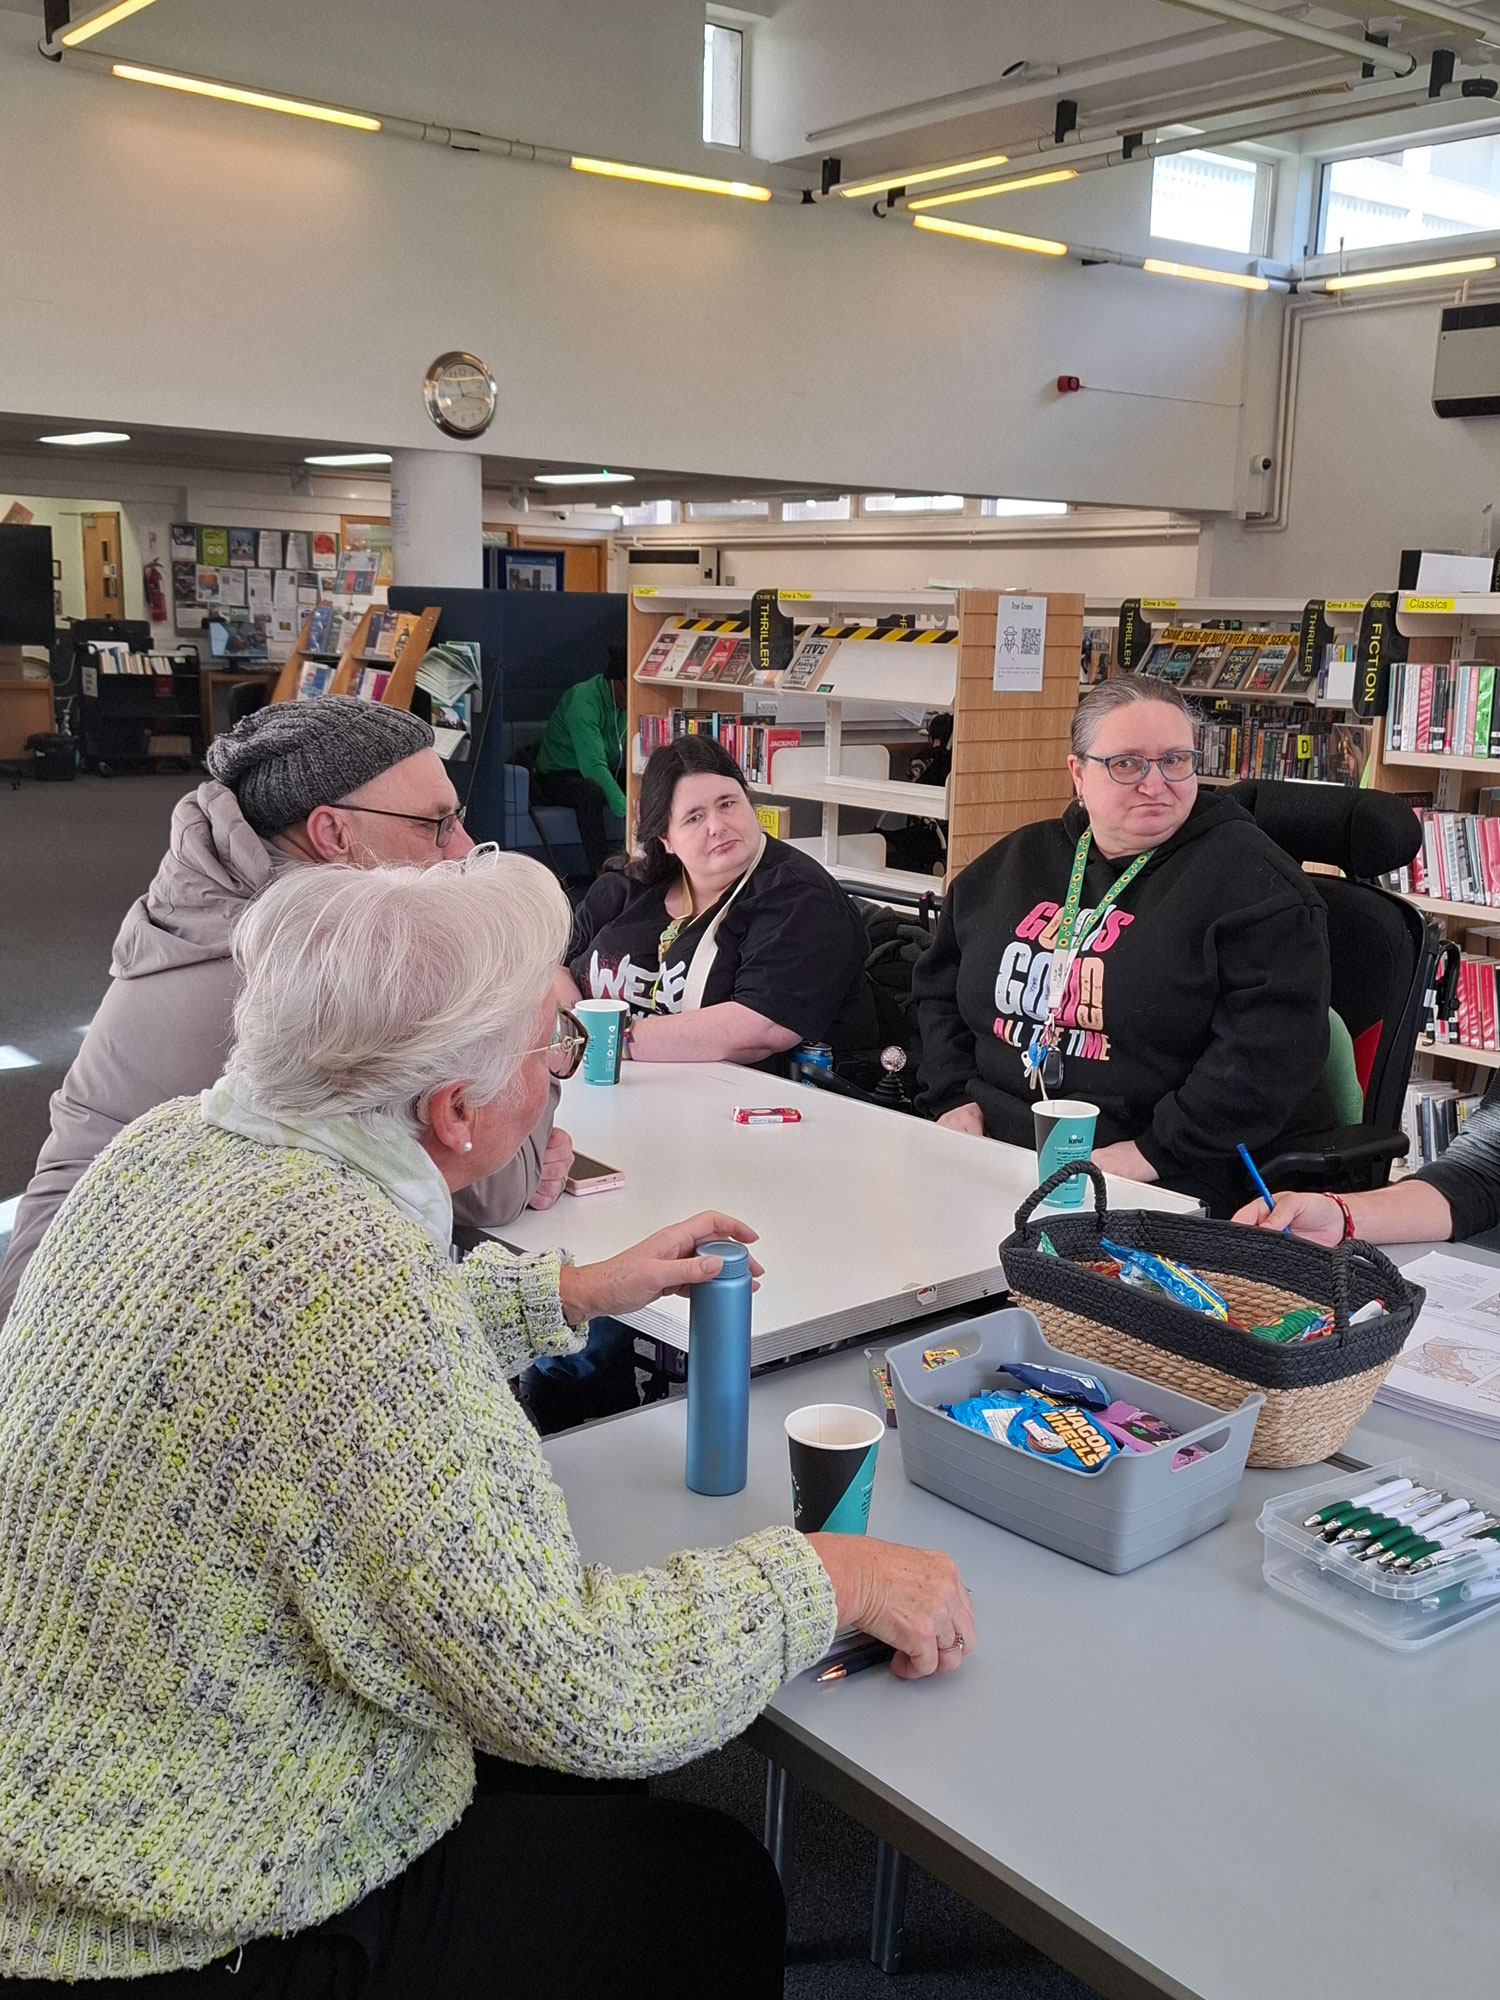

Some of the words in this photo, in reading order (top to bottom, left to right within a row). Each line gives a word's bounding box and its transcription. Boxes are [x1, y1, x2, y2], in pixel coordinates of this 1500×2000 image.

[1370, 600, 1391, 608] GENERAL
[1409, 599, 1448, 610] Classics
[760, 603, 770, 668] THRILLER
[1123, 610, 1134, 666] THRILLER
[1161, 628, 1182, 640] CRIME
[1224, 632, 1245, 644] ENTER
[1246, 633, 1269, 645] CRIME
[1304, 612, 1318, 673] THRILLER
[801, 643, 829, 655] FIVE
[1230, 663, 1242, 671] ME
[1364, 623, 1382, 702] FICTION
[1220, 672, 1241, 683] NOT
[1301, 739, 1309, 754] D
[993, 1017, 1024, 1048] ALL
[1066, 1029, 1112, 1061] TIME
